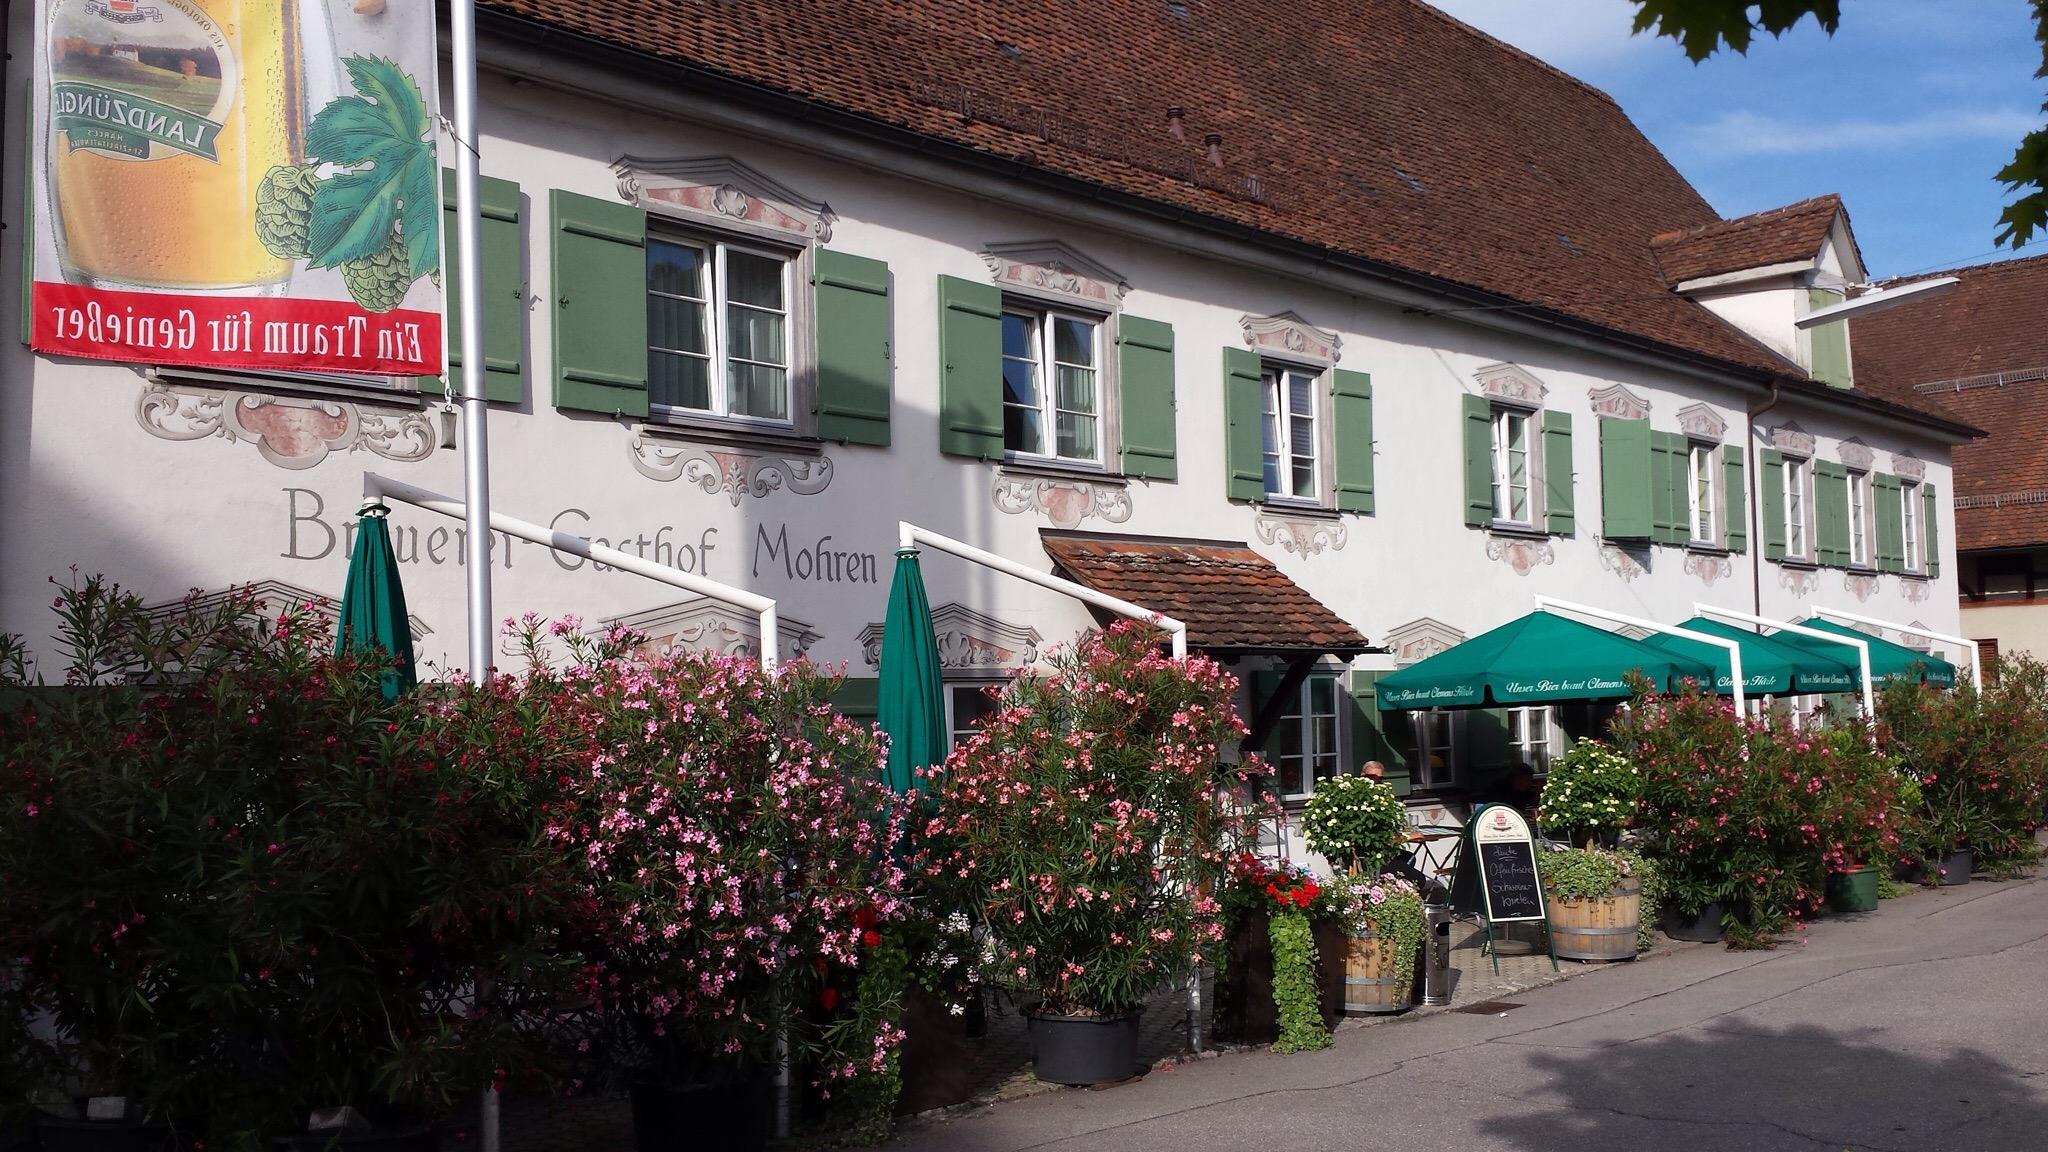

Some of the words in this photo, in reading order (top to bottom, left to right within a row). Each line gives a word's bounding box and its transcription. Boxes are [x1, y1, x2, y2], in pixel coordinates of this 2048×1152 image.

[752, 521, 878, 585] Mohren
[1536, 679, 1559, 692] Bier
[1587, 677, 1623, 689] Clemens
